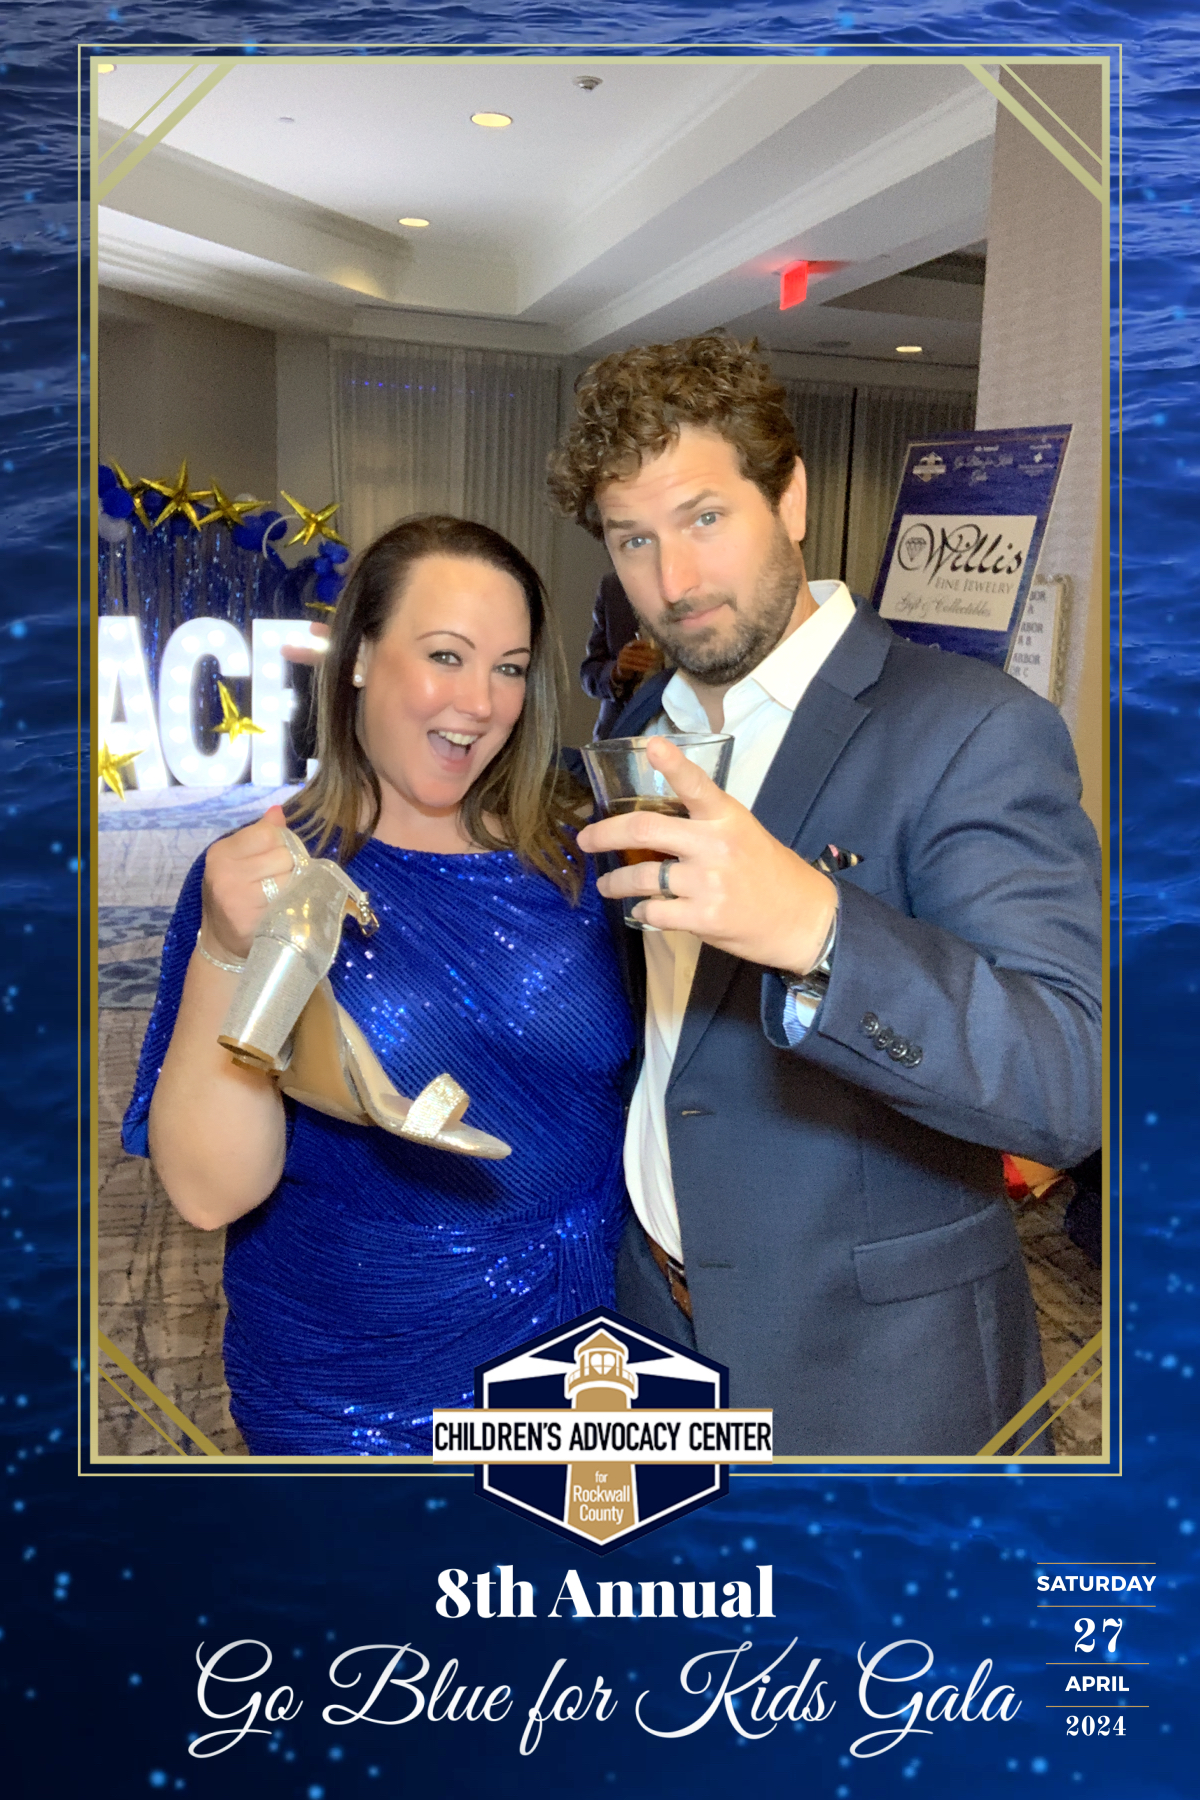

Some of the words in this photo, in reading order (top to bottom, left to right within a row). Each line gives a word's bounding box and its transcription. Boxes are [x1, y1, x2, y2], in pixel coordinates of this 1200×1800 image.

[897, 523, 1023, 585] Willis
[934, 577, 960, 592] FINE
[963, 578, 1014, 595] JEWELRY
